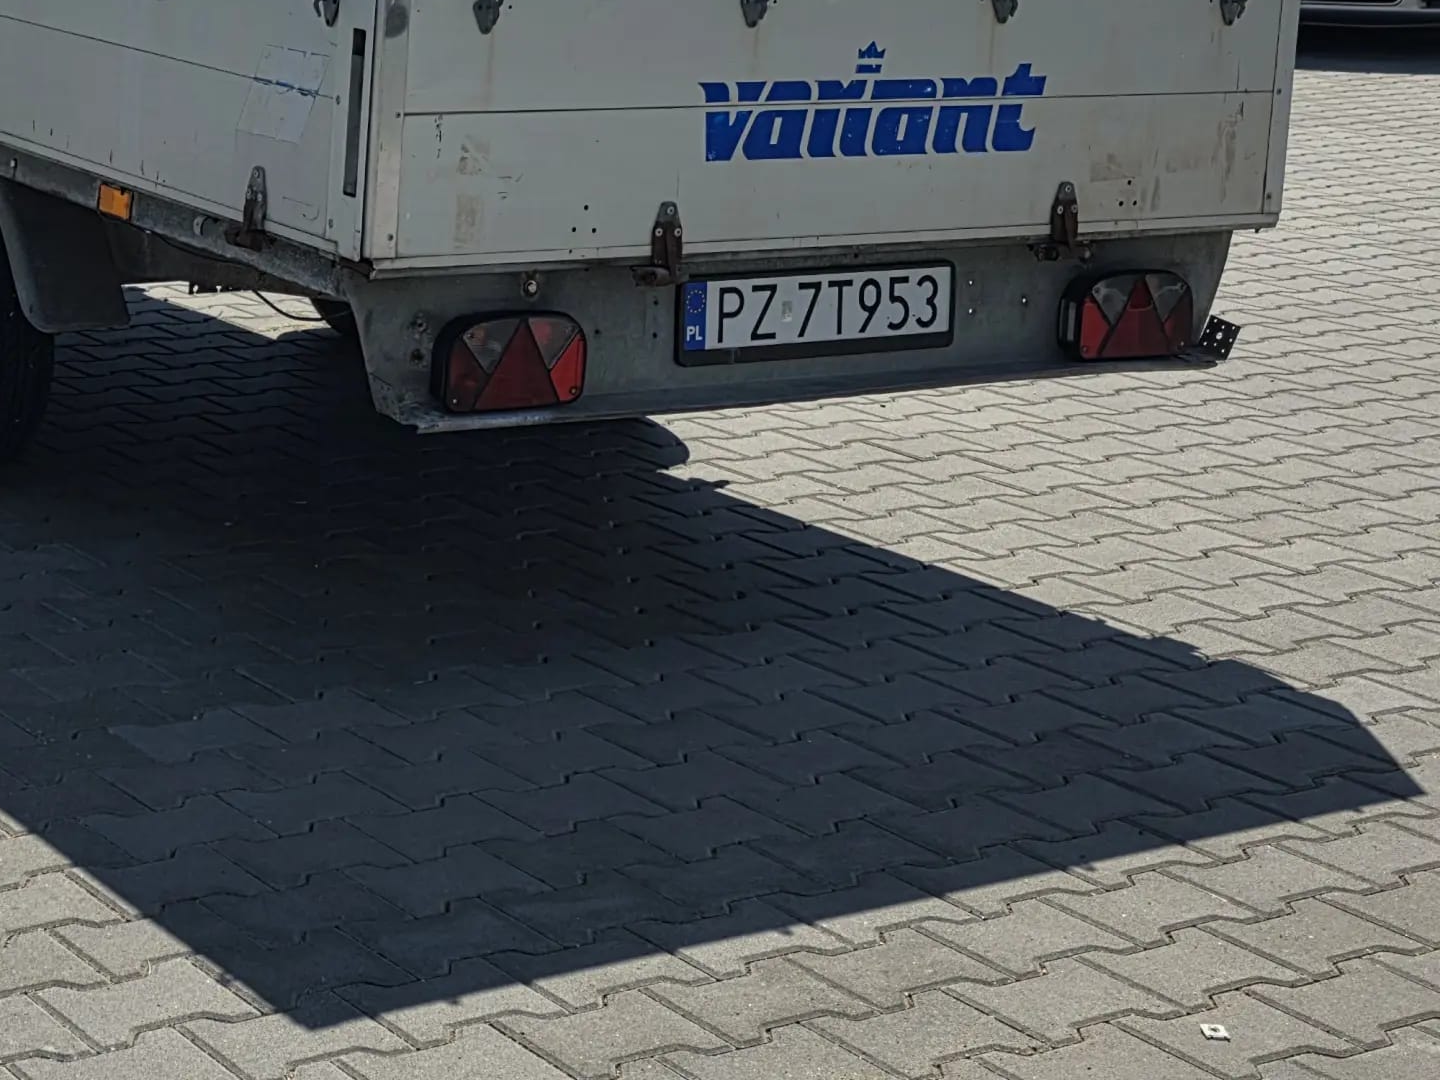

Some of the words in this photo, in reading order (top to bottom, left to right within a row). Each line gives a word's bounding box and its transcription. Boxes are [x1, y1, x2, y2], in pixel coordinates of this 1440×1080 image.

[698, 62, 1047, 161] variant
[686, 324, 703, 341] PL
[717, 283, 778, 344] PZ
[797, 274, 939, 338] 7T953
